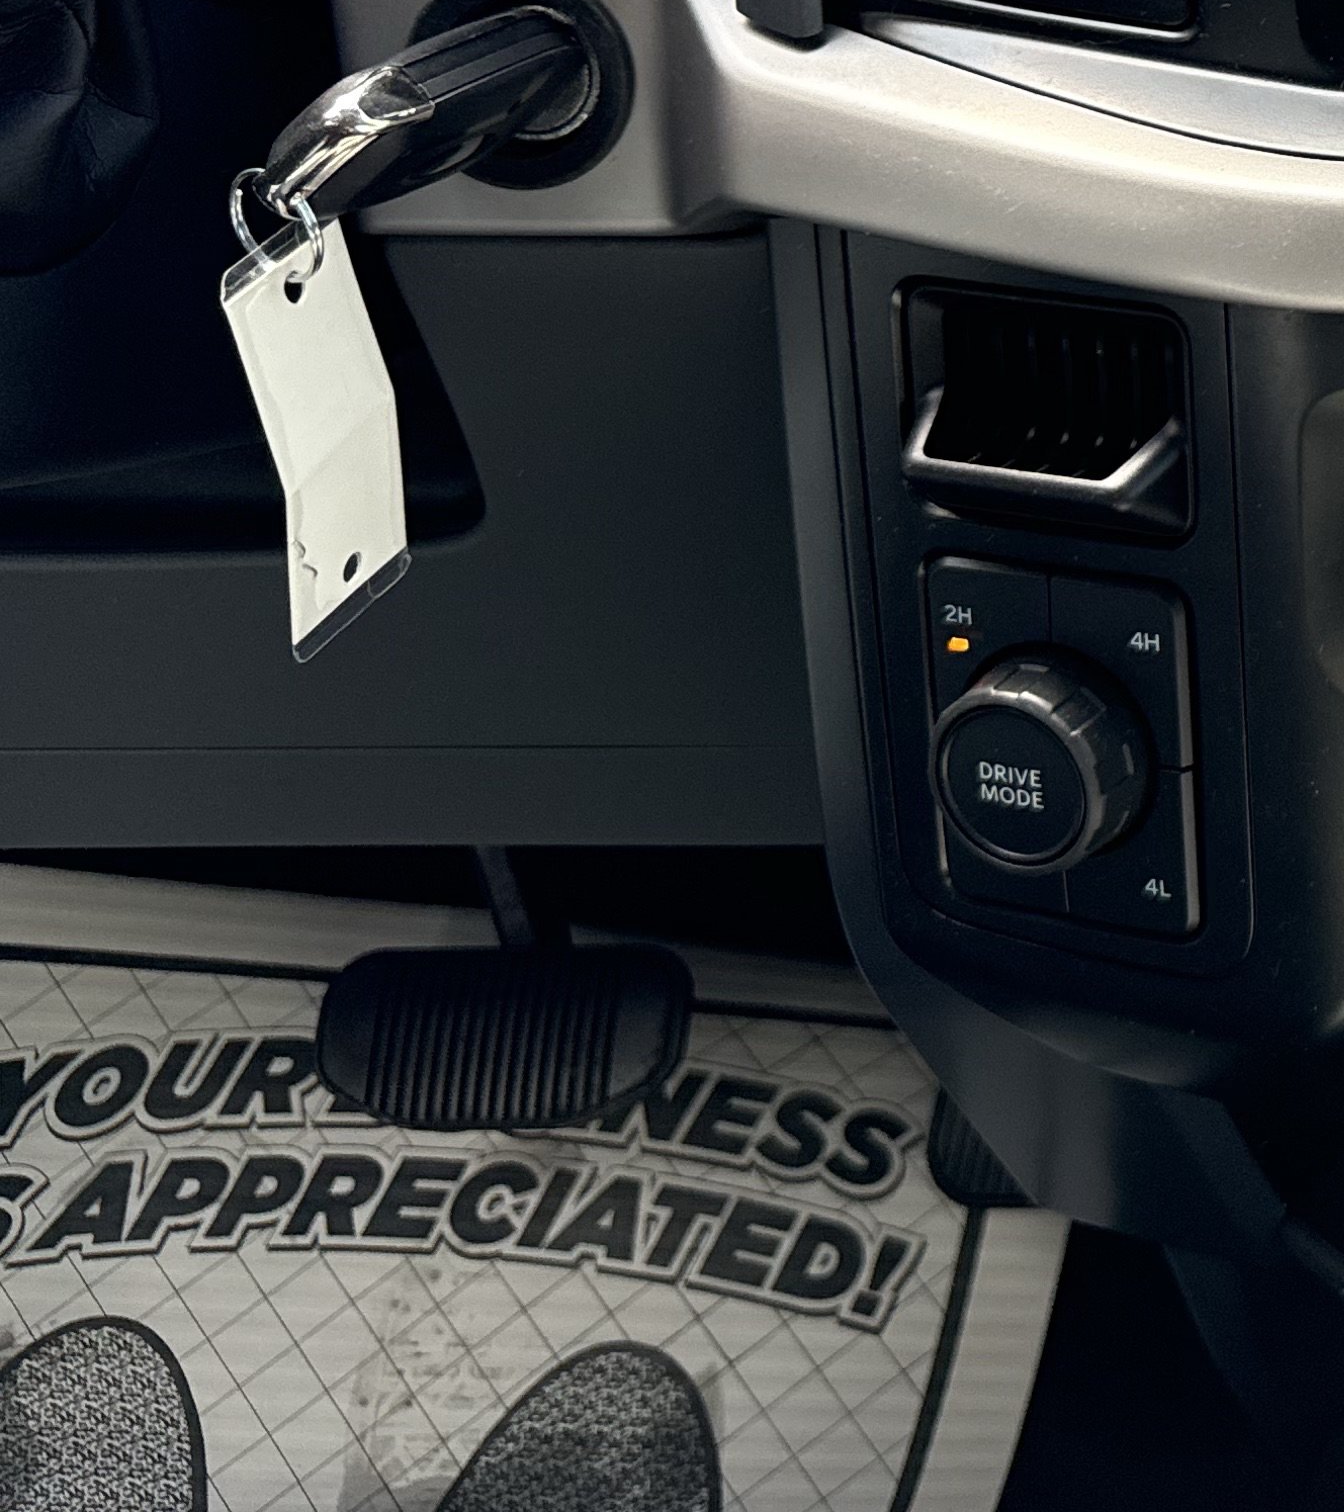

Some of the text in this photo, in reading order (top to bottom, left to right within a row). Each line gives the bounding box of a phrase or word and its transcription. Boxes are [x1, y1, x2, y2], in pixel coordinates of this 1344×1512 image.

[944, 604, 973, 625] 2H
[1130, 631, 1160, 652] 4H
[979, 761, 1042, 789] DRIVE
[980, 784, 1045, 810] MODE
[1144, 878, 1172, 898] 4L
[0, 1036, 322, 1140] YOUR
[20, 1148, 916, 1318] APPRECIATED!
